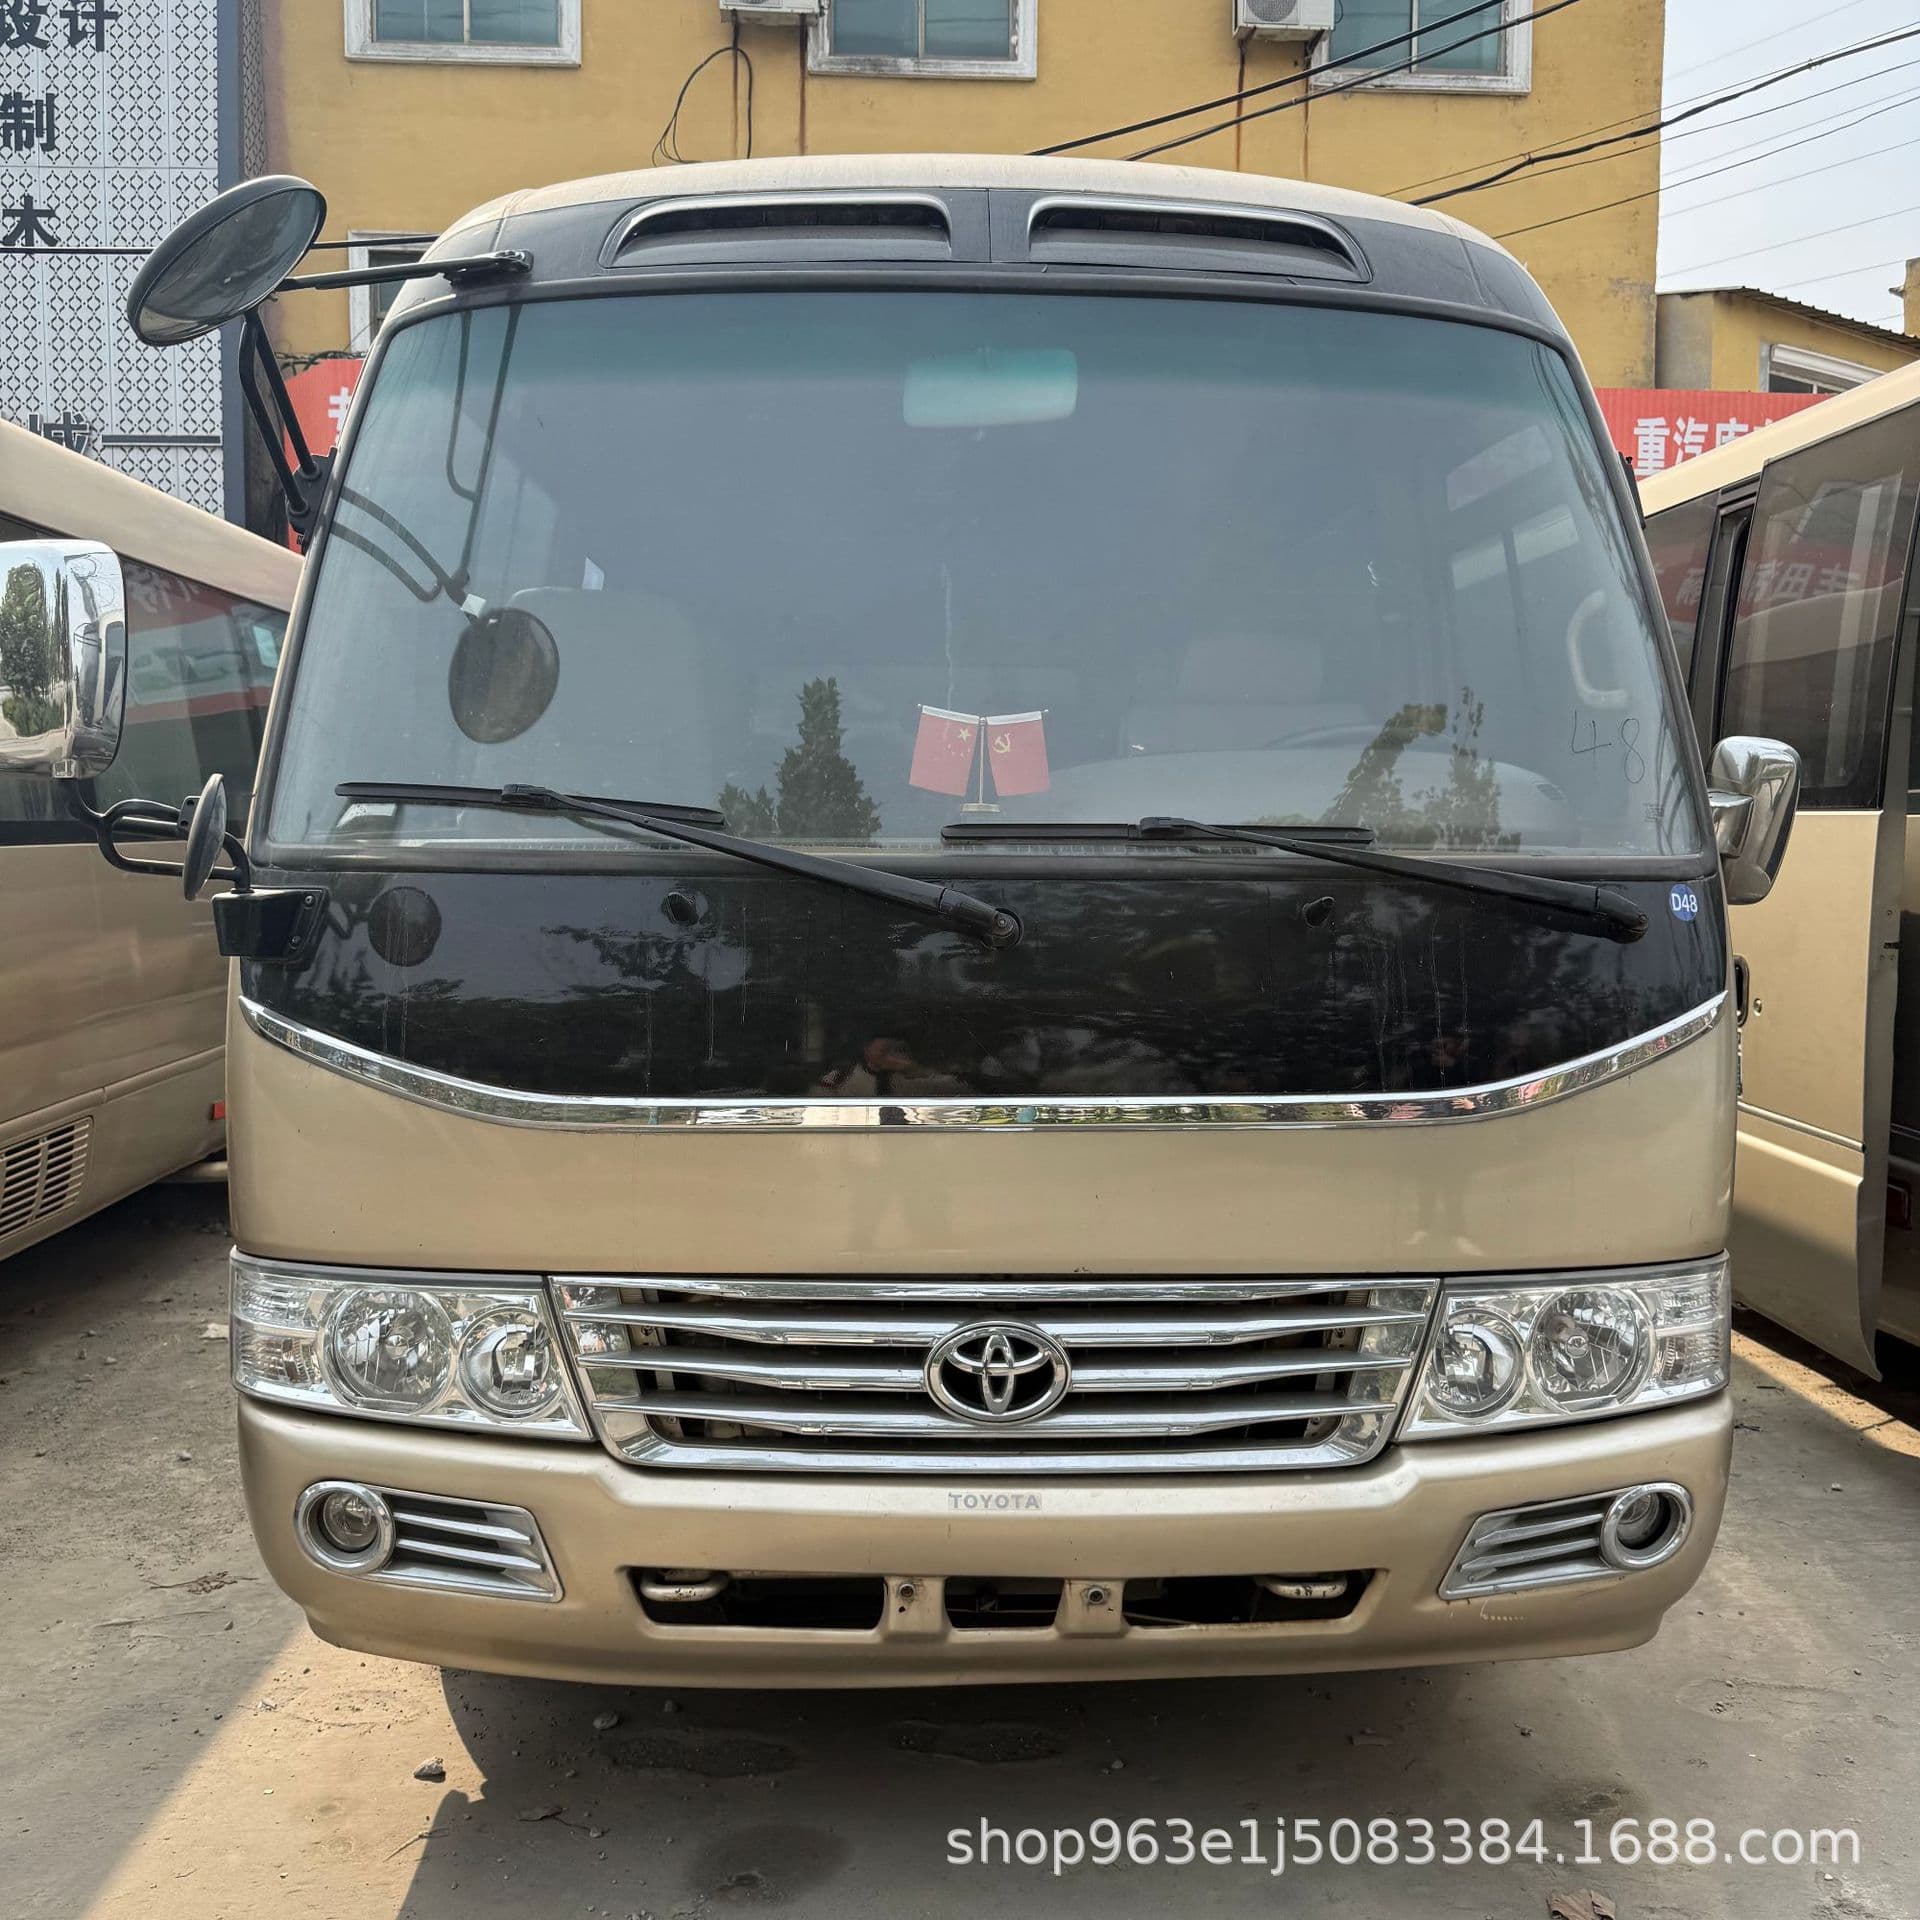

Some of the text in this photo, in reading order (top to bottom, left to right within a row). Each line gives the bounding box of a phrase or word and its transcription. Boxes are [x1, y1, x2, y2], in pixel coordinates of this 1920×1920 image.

[1571, 709, 1645, 783] 48
[1671, 893, 1698, 913] D48
[950, 1493, 1040, 1509] TOYOTA
